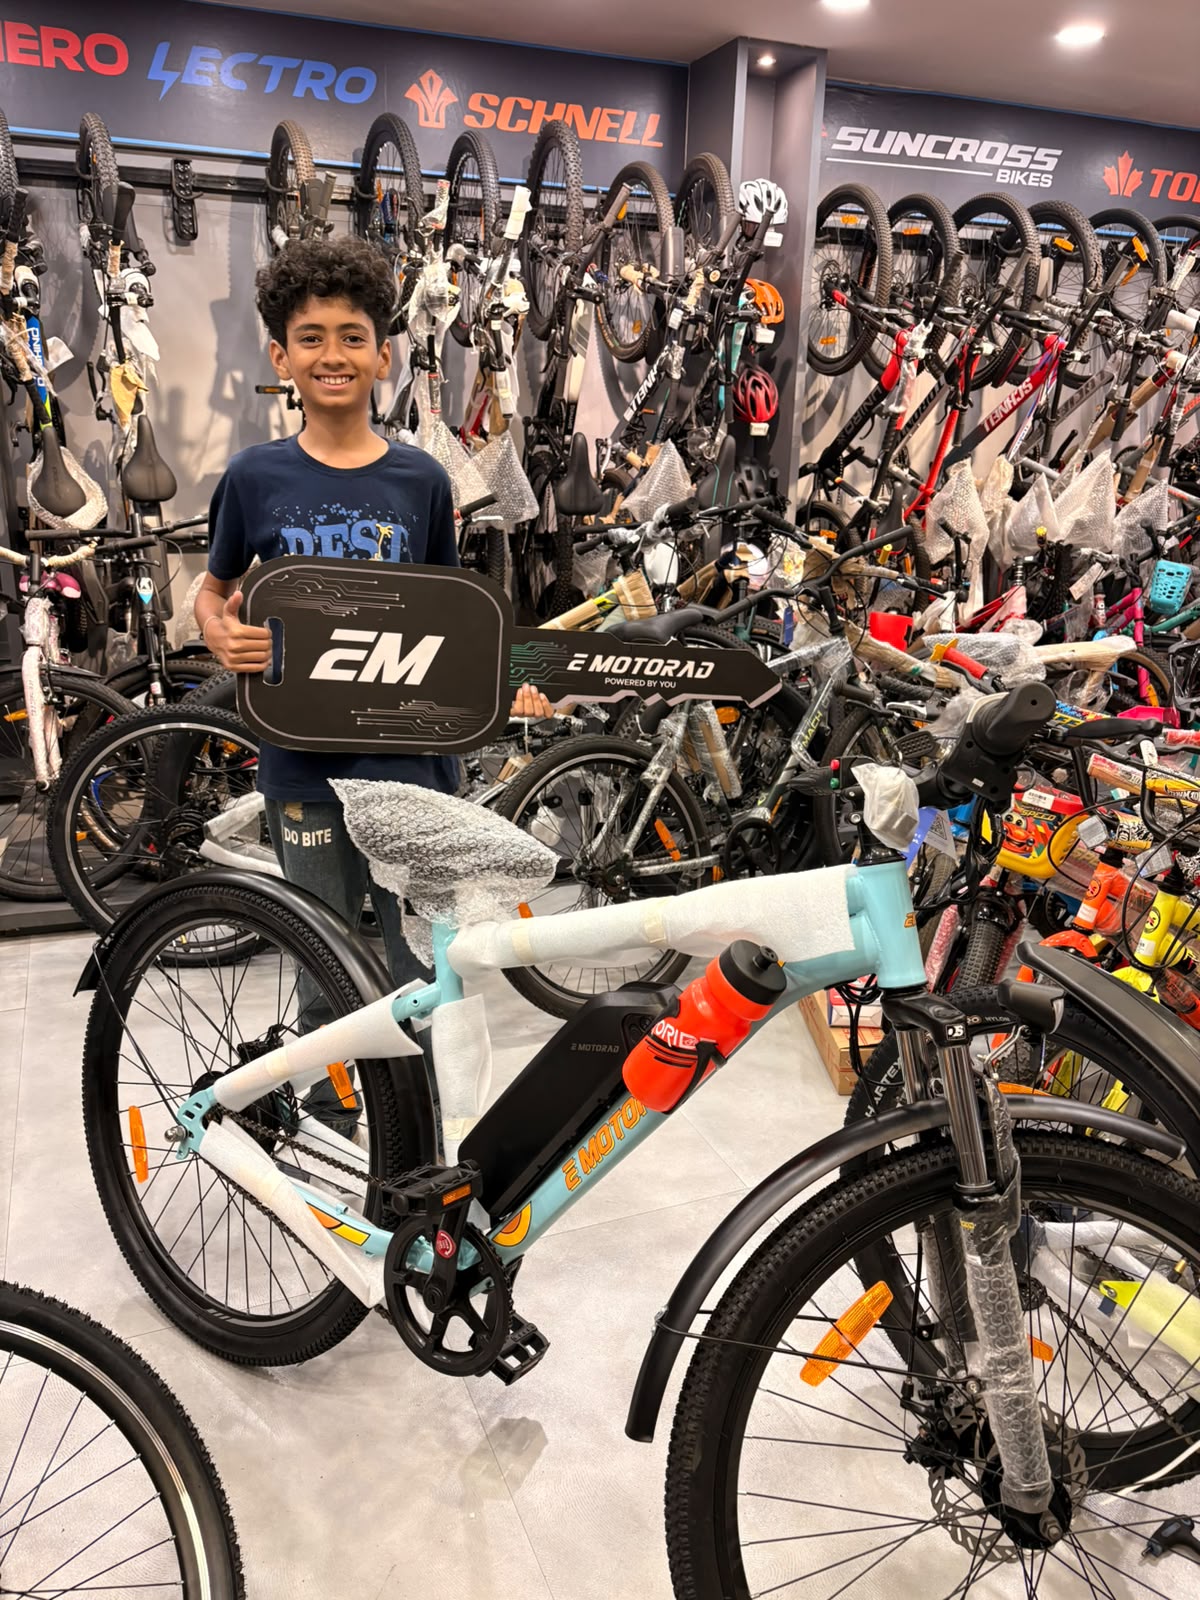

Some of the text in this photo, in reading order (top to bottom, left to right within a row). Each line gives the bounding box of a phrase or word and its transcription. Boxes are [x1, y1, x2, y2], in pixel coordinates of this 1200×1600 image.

[0, 20, 377, 104] ERO LECTRO
[464, 92, 663, 147] SCHNELL
[832, 126, 1062, 171] SUNCROSS
[995, 169, 1053, 188] BIKES
[981, 377, 1034, 433] SCHNELL
[309, 628, 445, 686] EM
[588, 654, 715, 679] MOTORAD
[604, 677, 676, 689] POWERED BY YOU
[802, 711, 823, 748] MACH
[283, 826, 332, 847] DO BITE
[578, 1043, 620, 1053] MOTORAD
